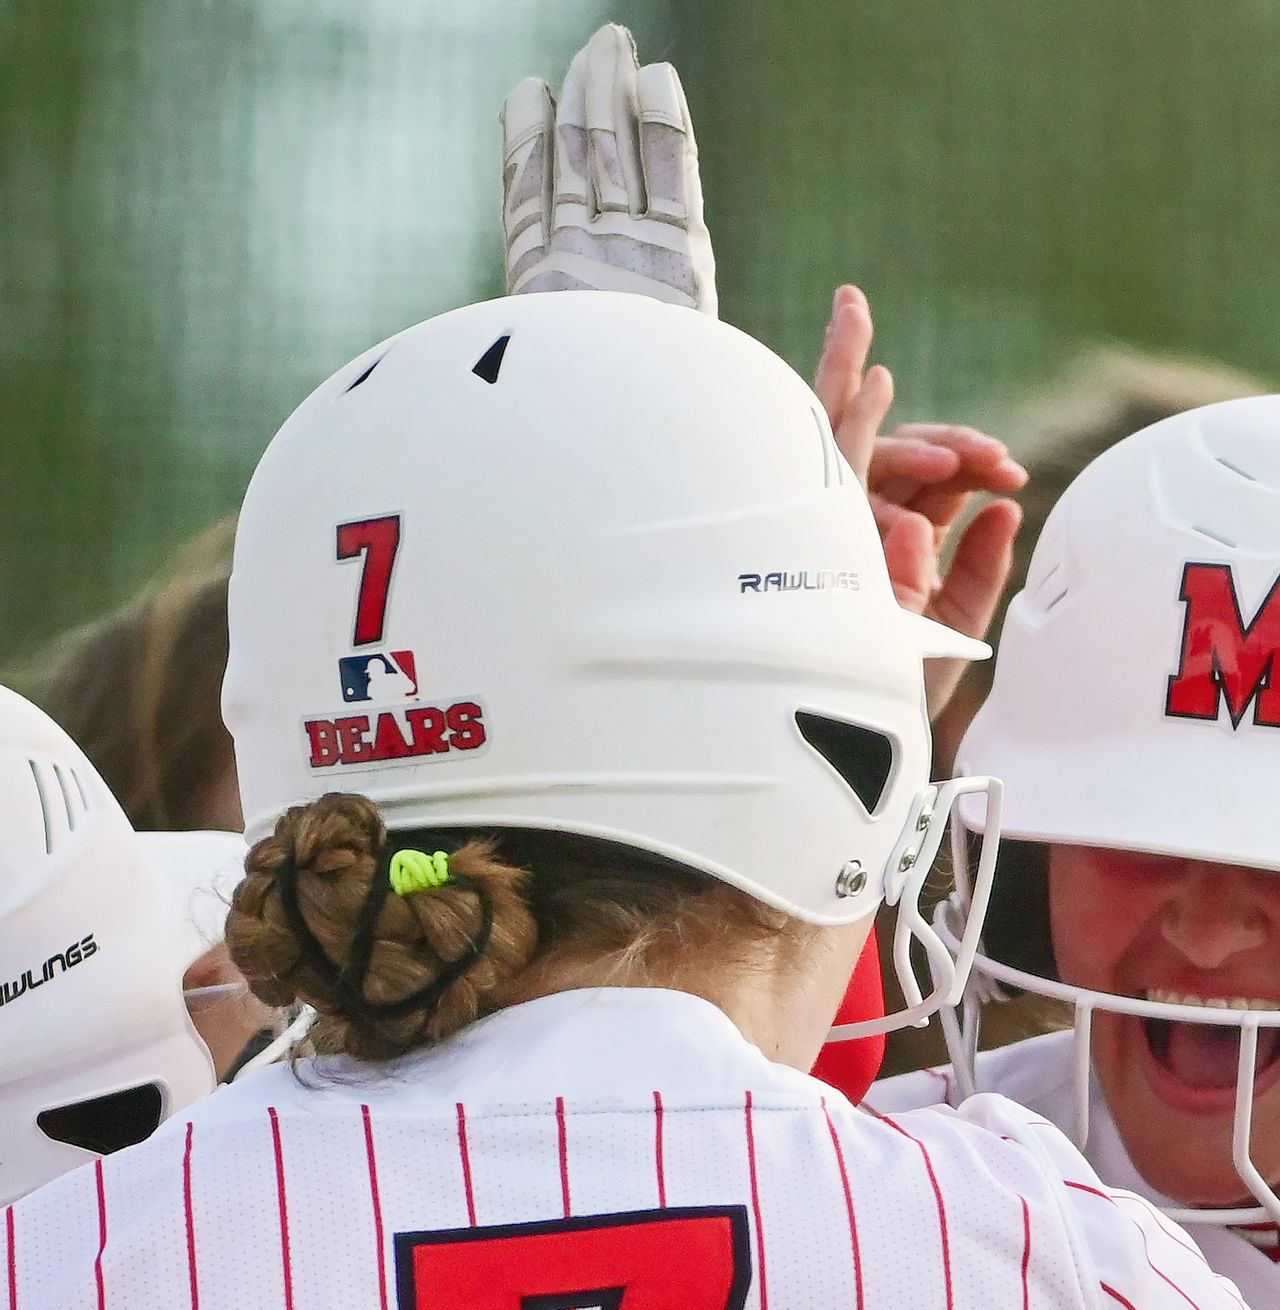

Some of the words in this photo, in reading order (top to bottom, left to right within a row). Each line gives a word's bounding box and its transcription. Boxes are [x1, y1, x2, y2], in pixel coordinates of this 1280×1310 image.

[336, 514, 401, 647] 7
[738, 571, 862, 594] RAWLINGS
[304, 701, 487, 768] BEARS
[0, 932, 96, 1008] WLINGS
